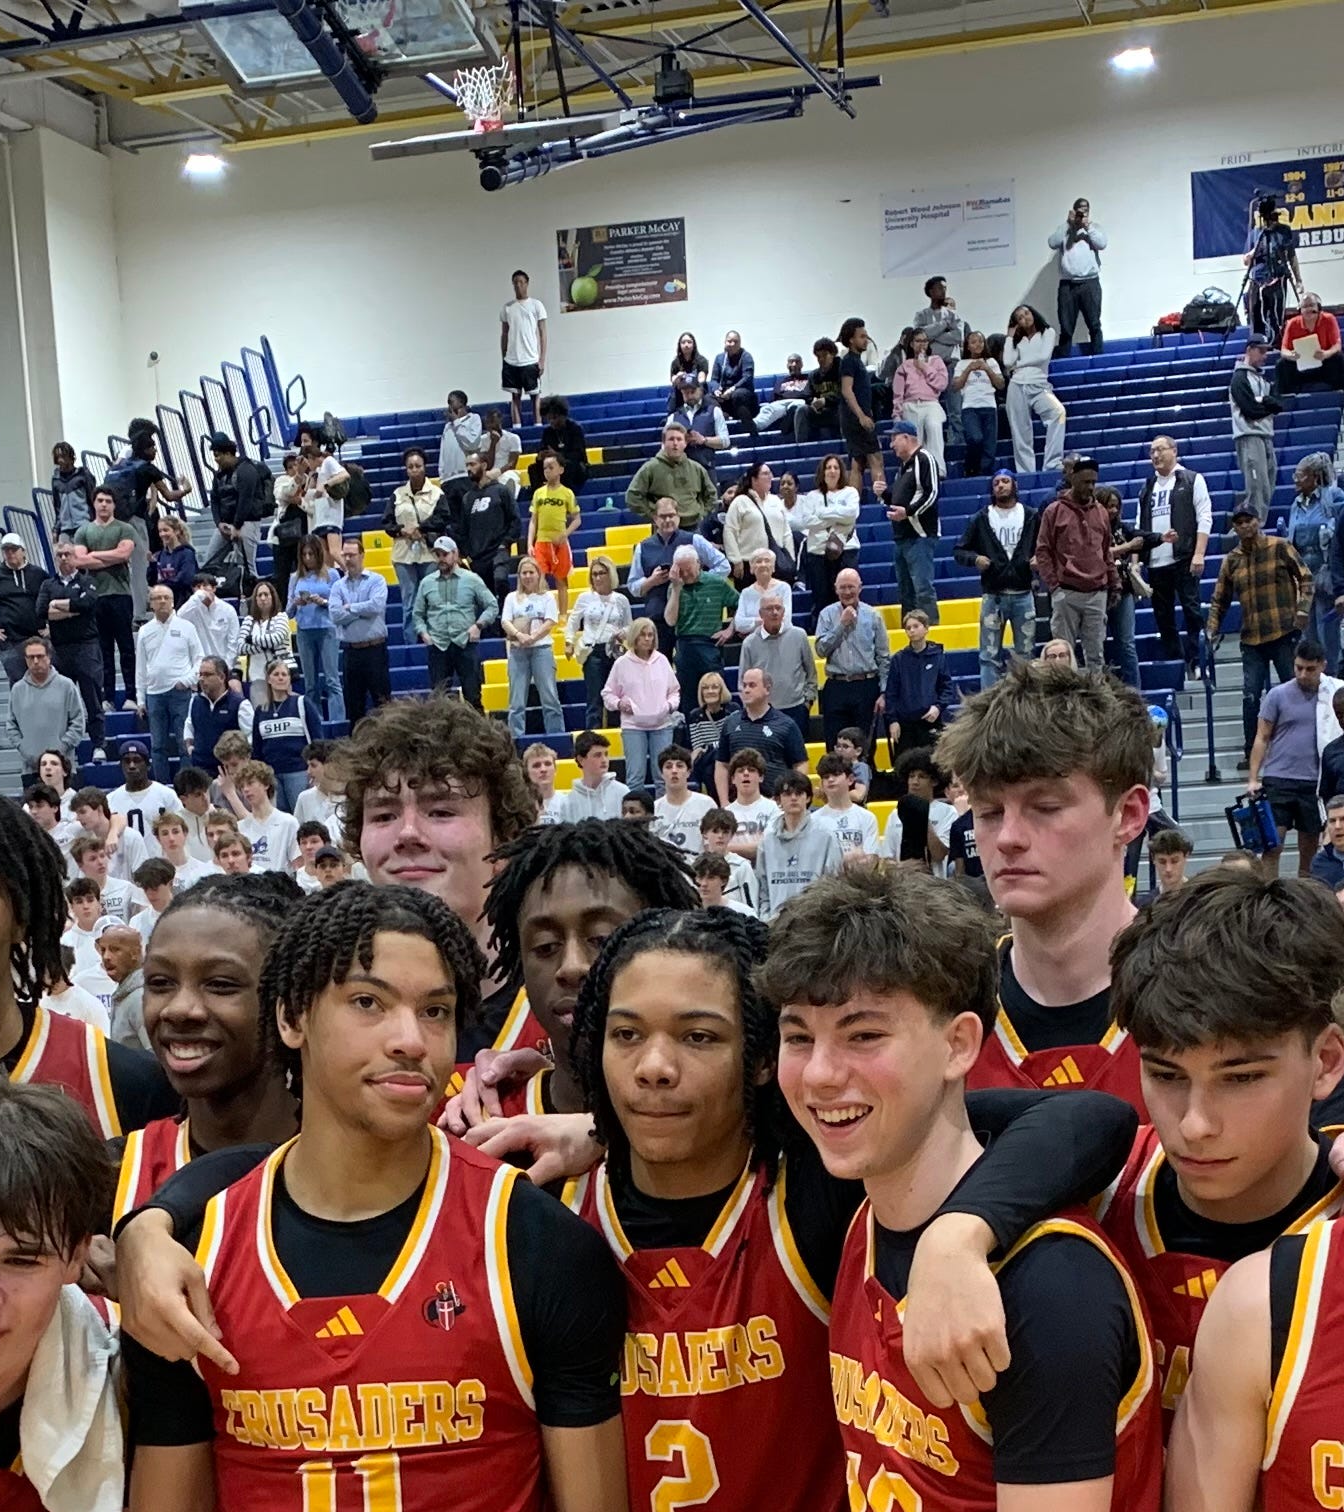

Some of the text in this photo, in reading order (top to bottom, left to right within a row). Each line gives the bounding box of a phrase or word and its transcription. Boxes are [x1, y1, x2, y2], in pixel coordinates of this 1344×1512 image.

[1220, 153, 1252, 166] PRIDE
[910, 204, 931, 214] Wood
[609, 225, 647, 238] PARKER
[648, 221, 681, 234] McCAY
[884, 222, 918, 231] Somerset
[264, 721, 291, 734] SHP
[220, 1379, 487, 1452] CRUSADERS
[829, 1351, 960, 1477] RUSADERS
